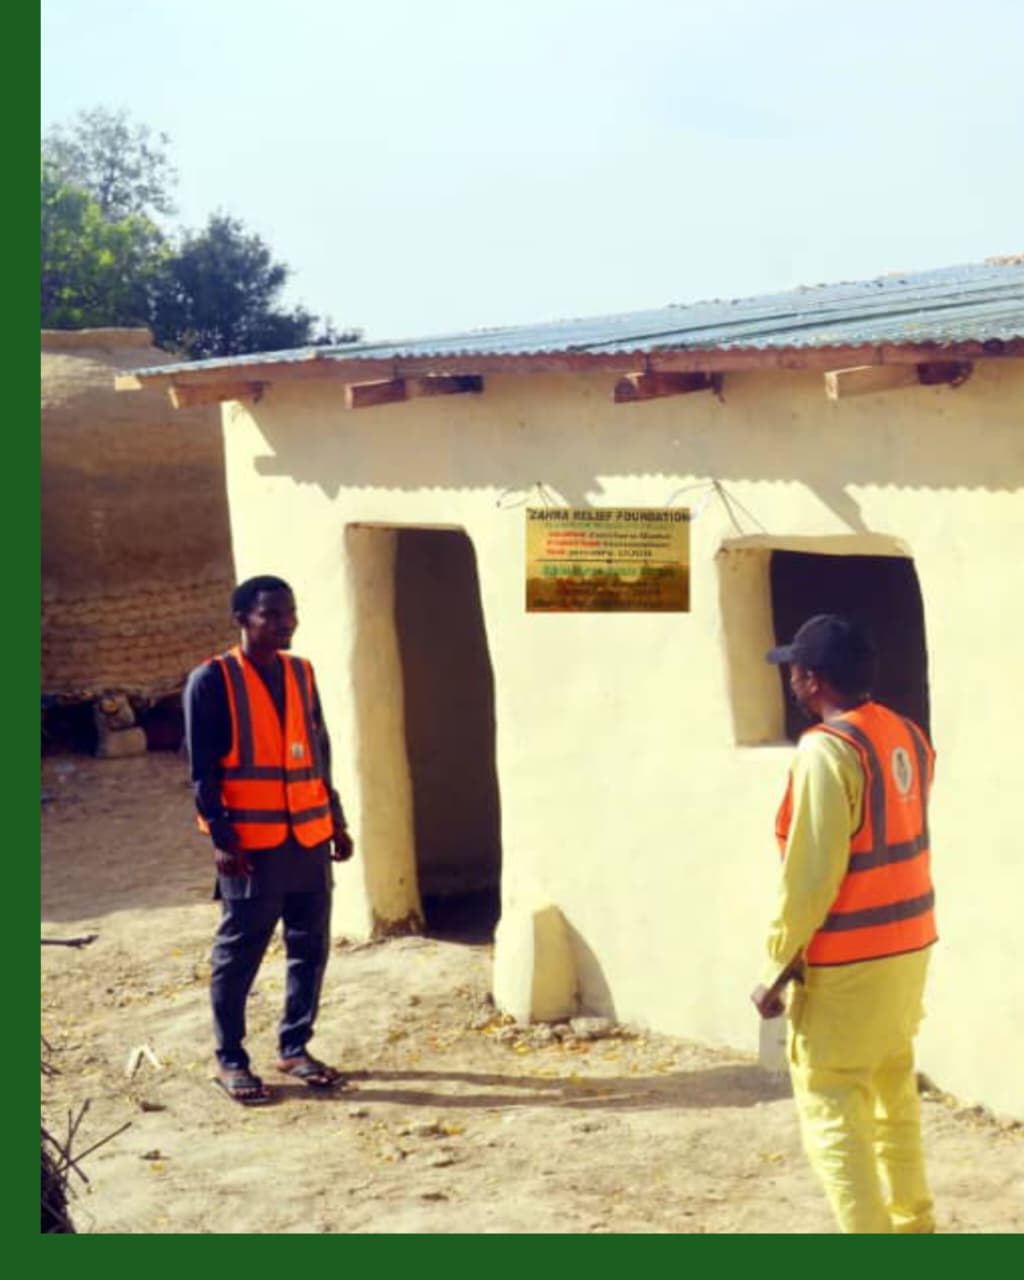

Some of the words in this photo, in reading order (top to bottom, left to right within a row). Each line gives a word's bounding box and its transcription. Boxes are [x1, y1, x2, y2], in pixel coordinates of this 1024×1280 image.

[529, 510, 569, 521] ZAHRA
[573, 510, 613, 521] RELIEF
[616, 510, 692, 522] FOUNDATION
